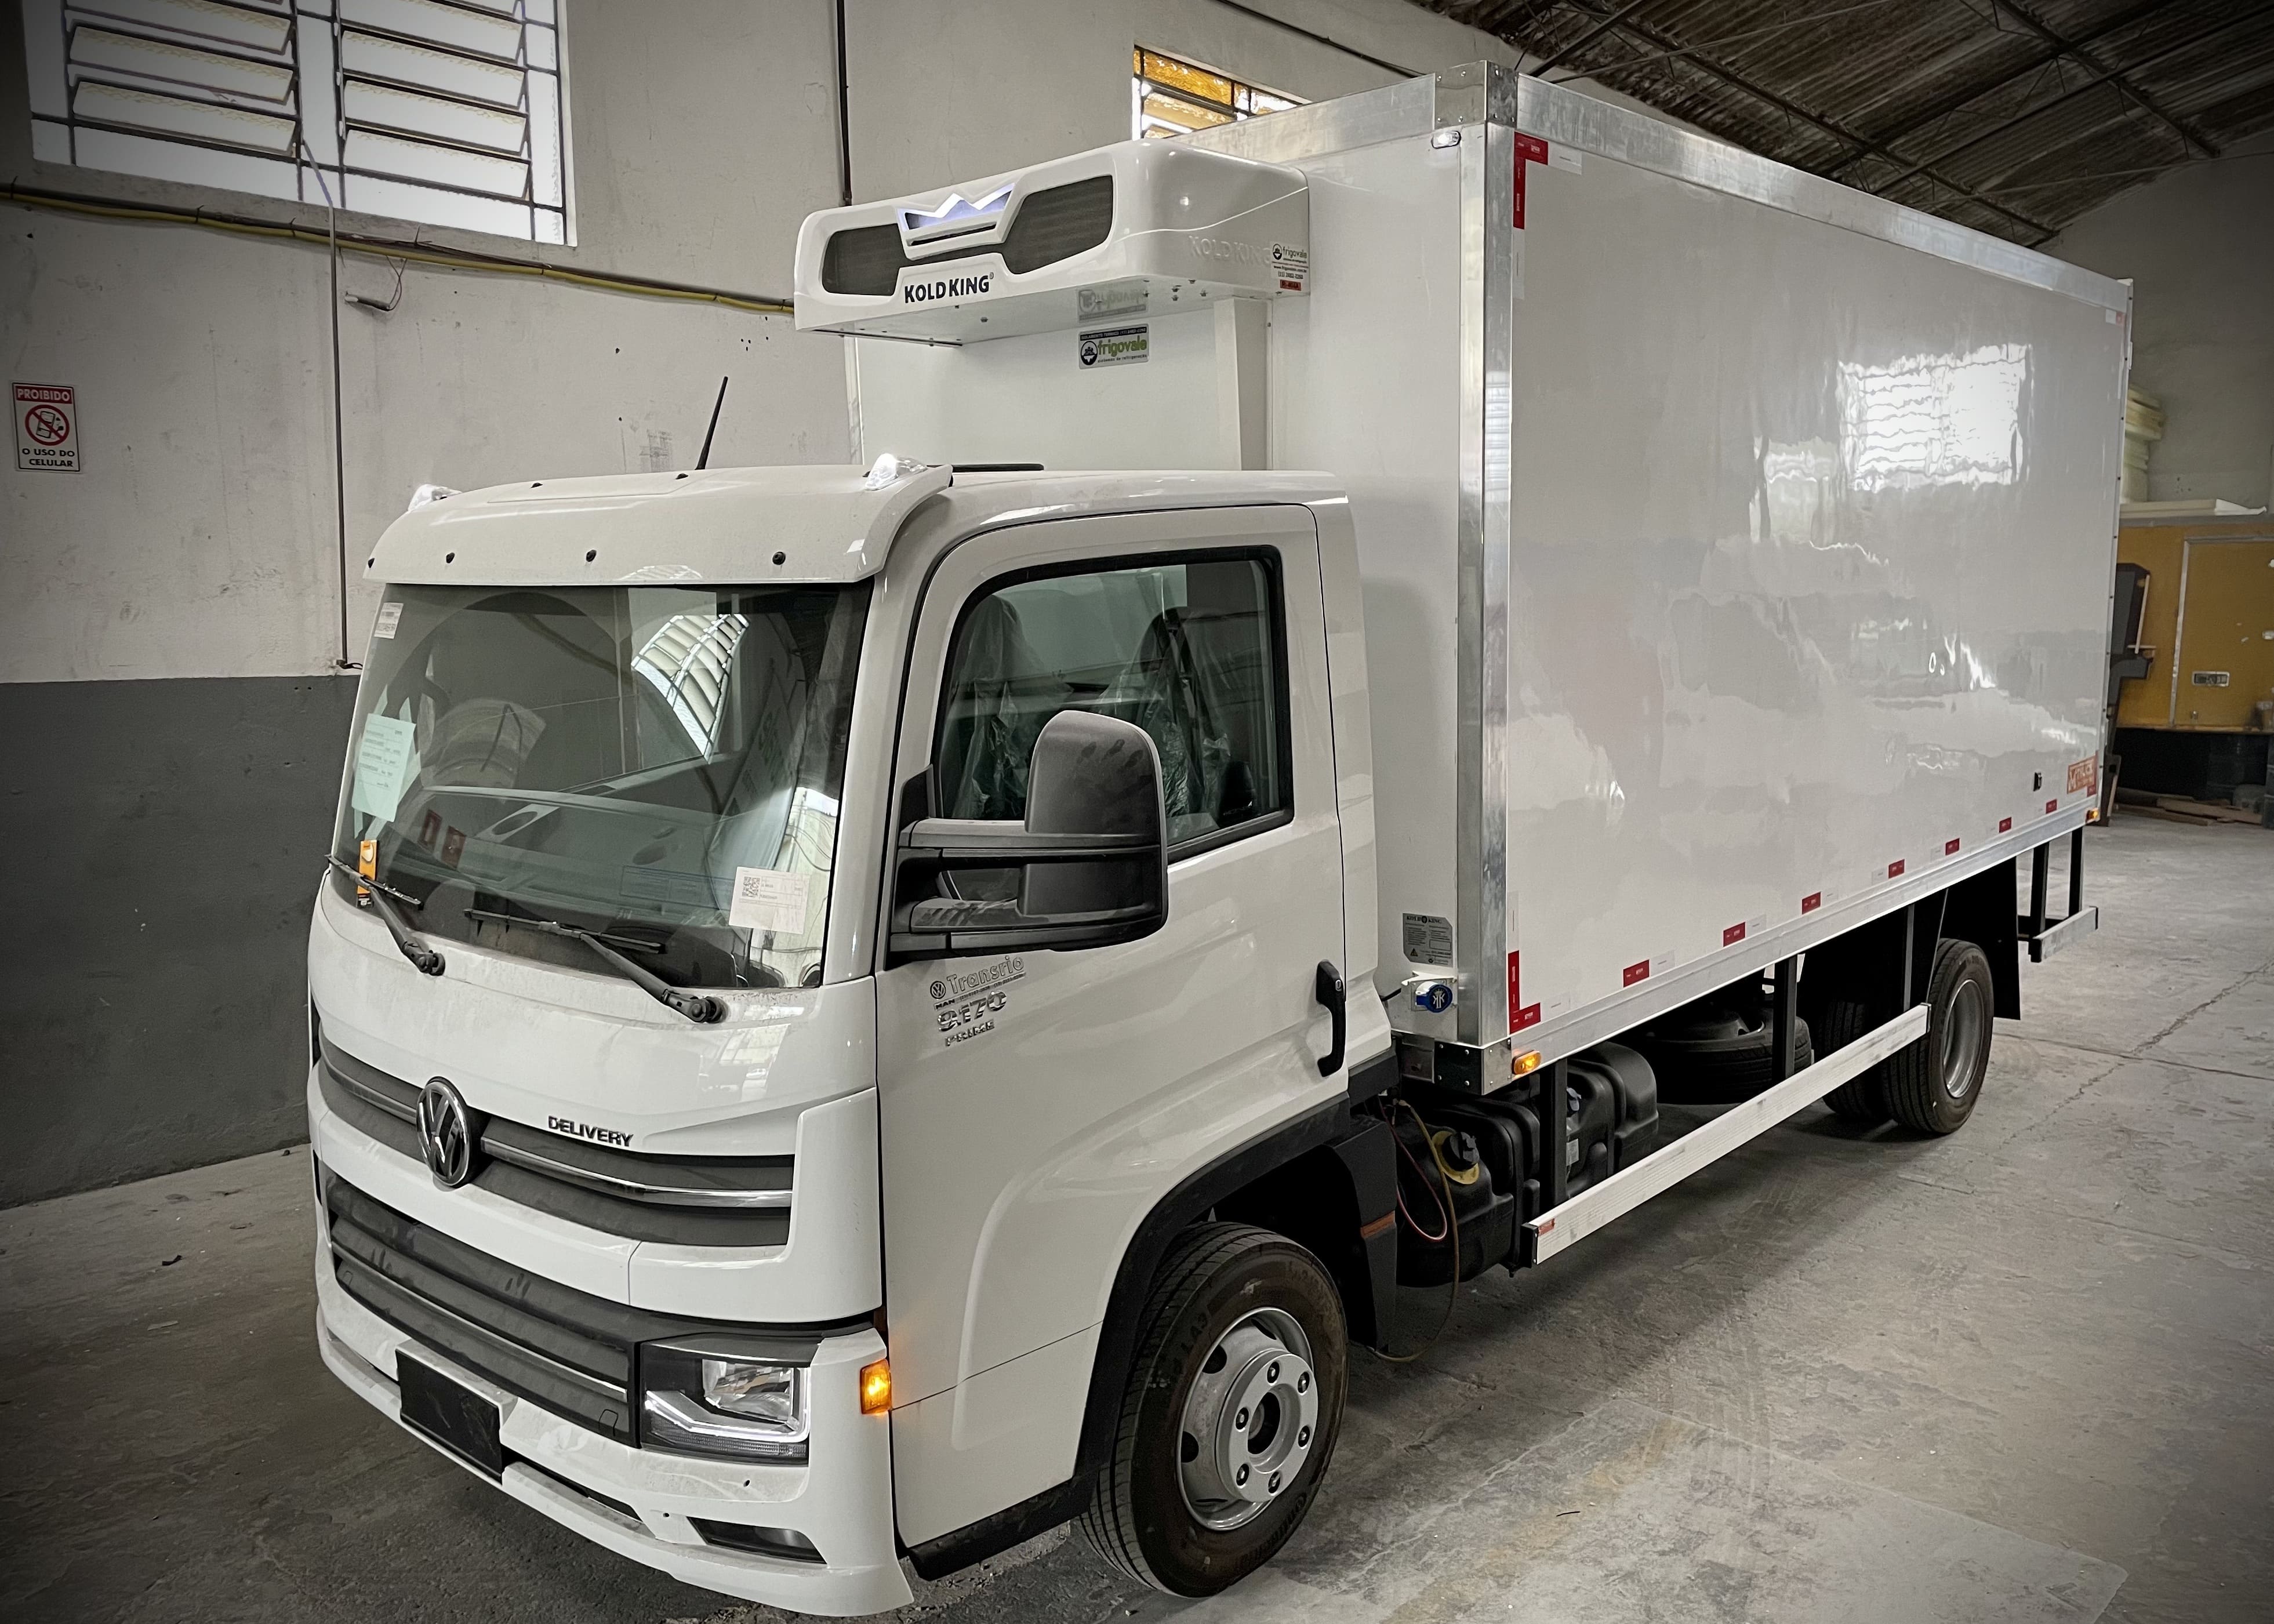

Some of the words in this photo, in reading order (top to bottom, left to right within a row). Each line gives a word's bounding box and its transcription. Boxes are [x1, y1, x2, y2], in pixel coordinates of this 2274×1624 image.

[1097, 335, 1147, 357] frigovale
[17, 388, 70, 402] PROIBIDO
[29, 459, 73, 467] CELULAR
[946, 955, 1025, 994] Transrio
[935, 998, 956, 1010] MAN
[945, 1018, 995, 1047] PRIME
[548, 1115, 634, 1147] DELIVERY
